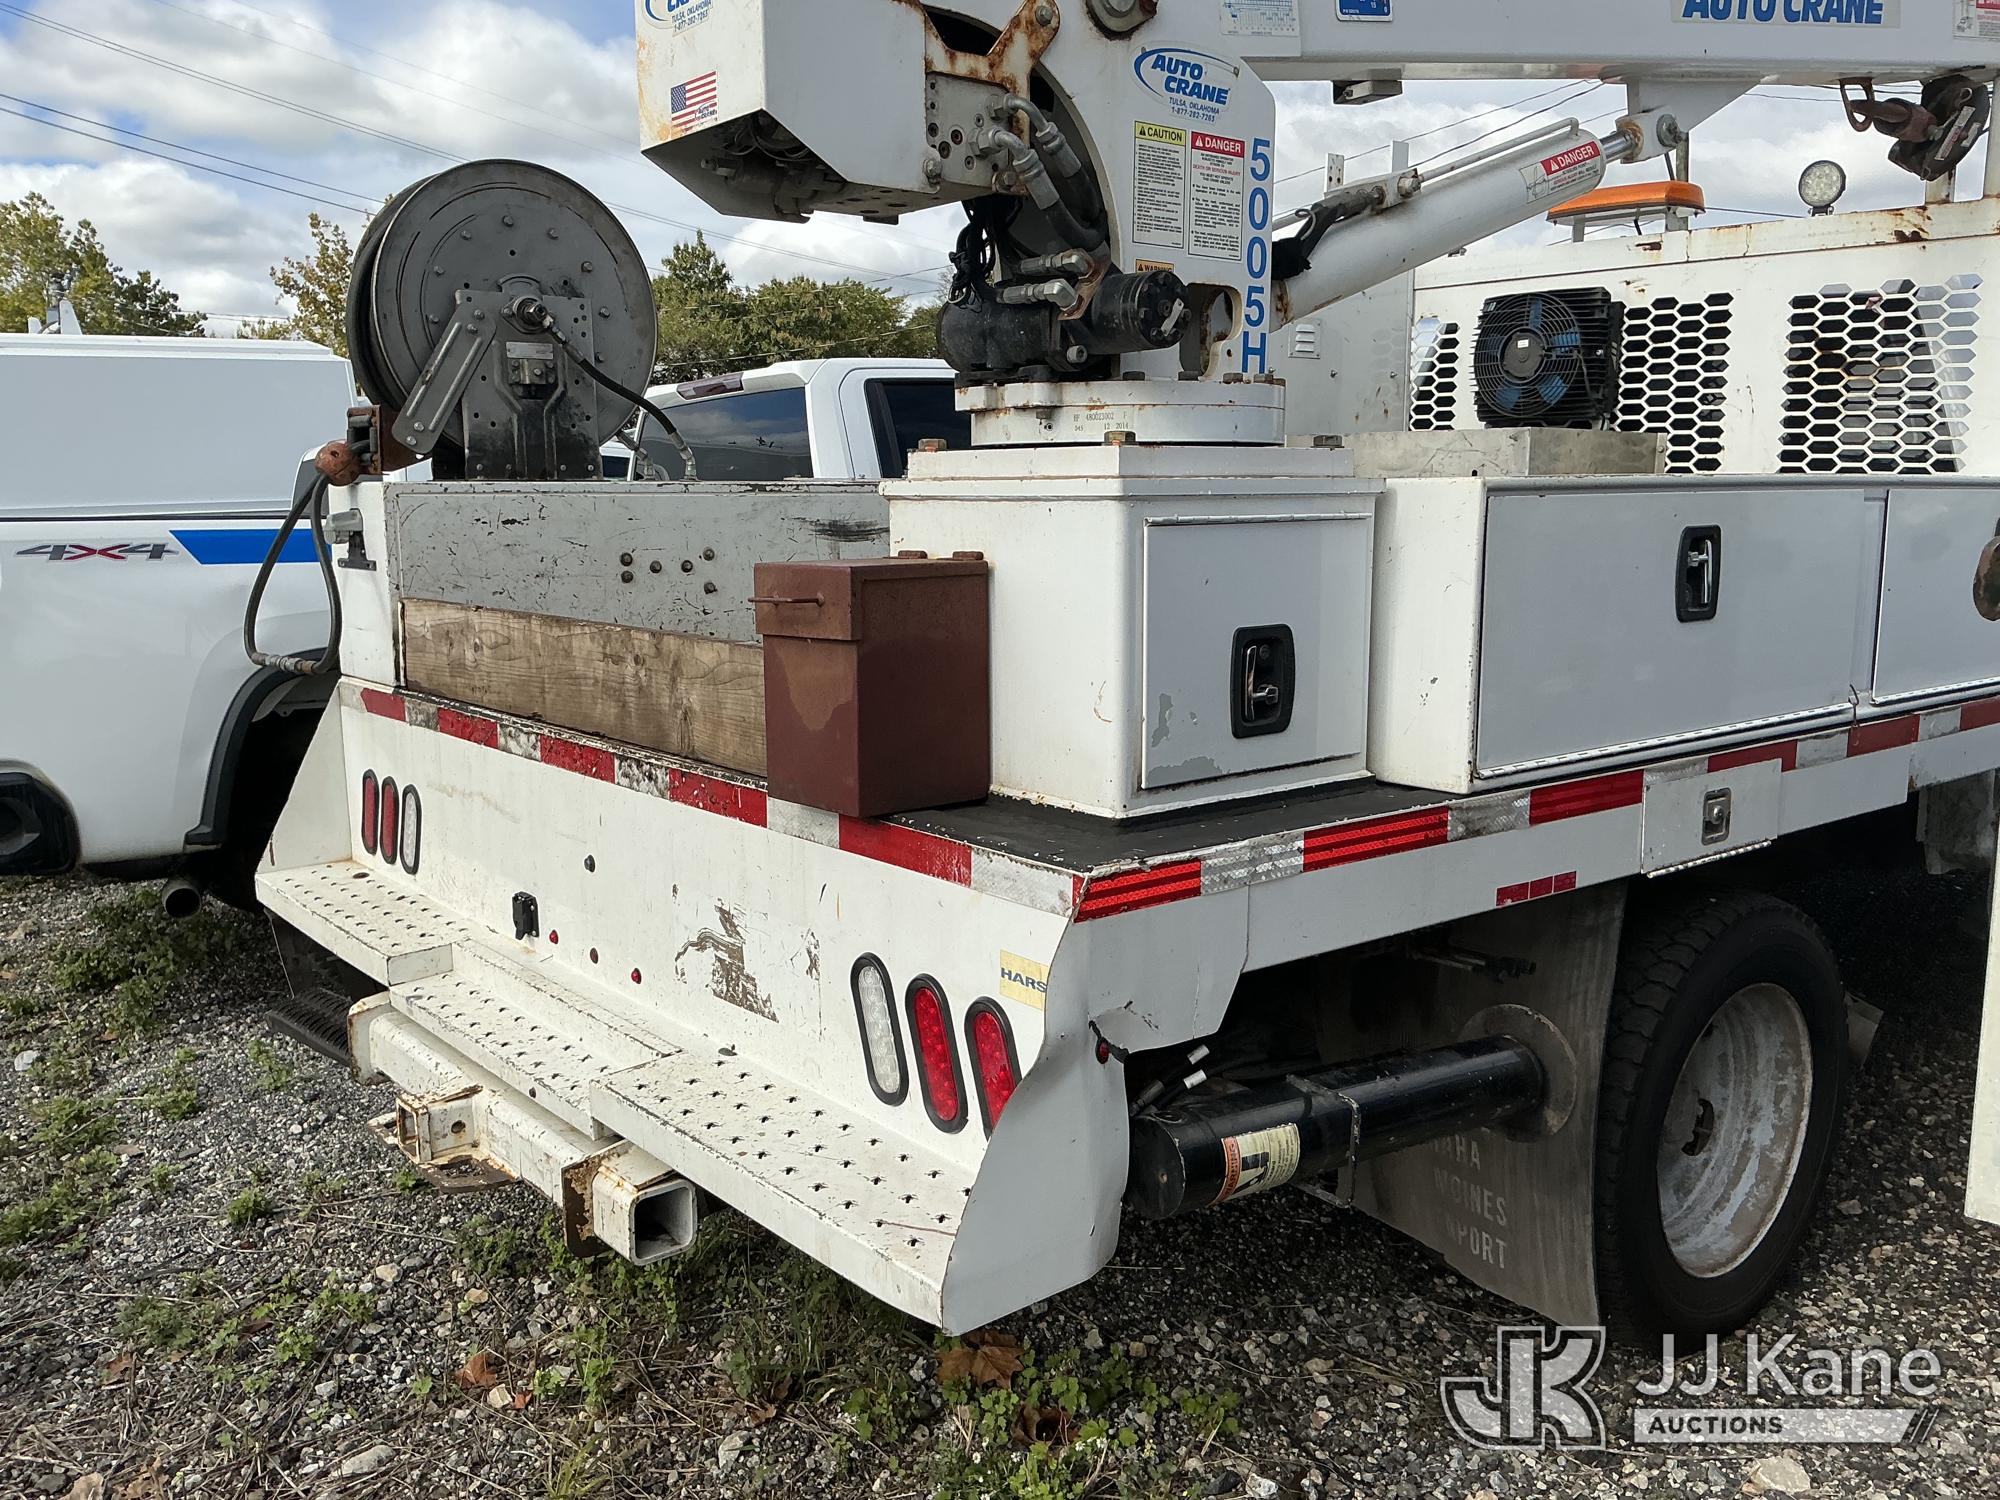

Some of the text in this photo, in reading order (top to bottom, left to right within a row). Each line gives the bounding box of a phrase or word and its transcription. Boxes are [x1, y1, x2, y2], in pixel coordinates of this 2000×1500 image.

[1151, 54, 1204, 80] AUTO
[1164, 75, 1229, 105] CRANE
[1169, 97, 1220, 114] TULSA, OKLAHOMA
[1147, 127, 1183, 142] CAUTION
[1205, 137, 1241, 153] DANGER
[1557, 145, 1594, 167] DANGER
